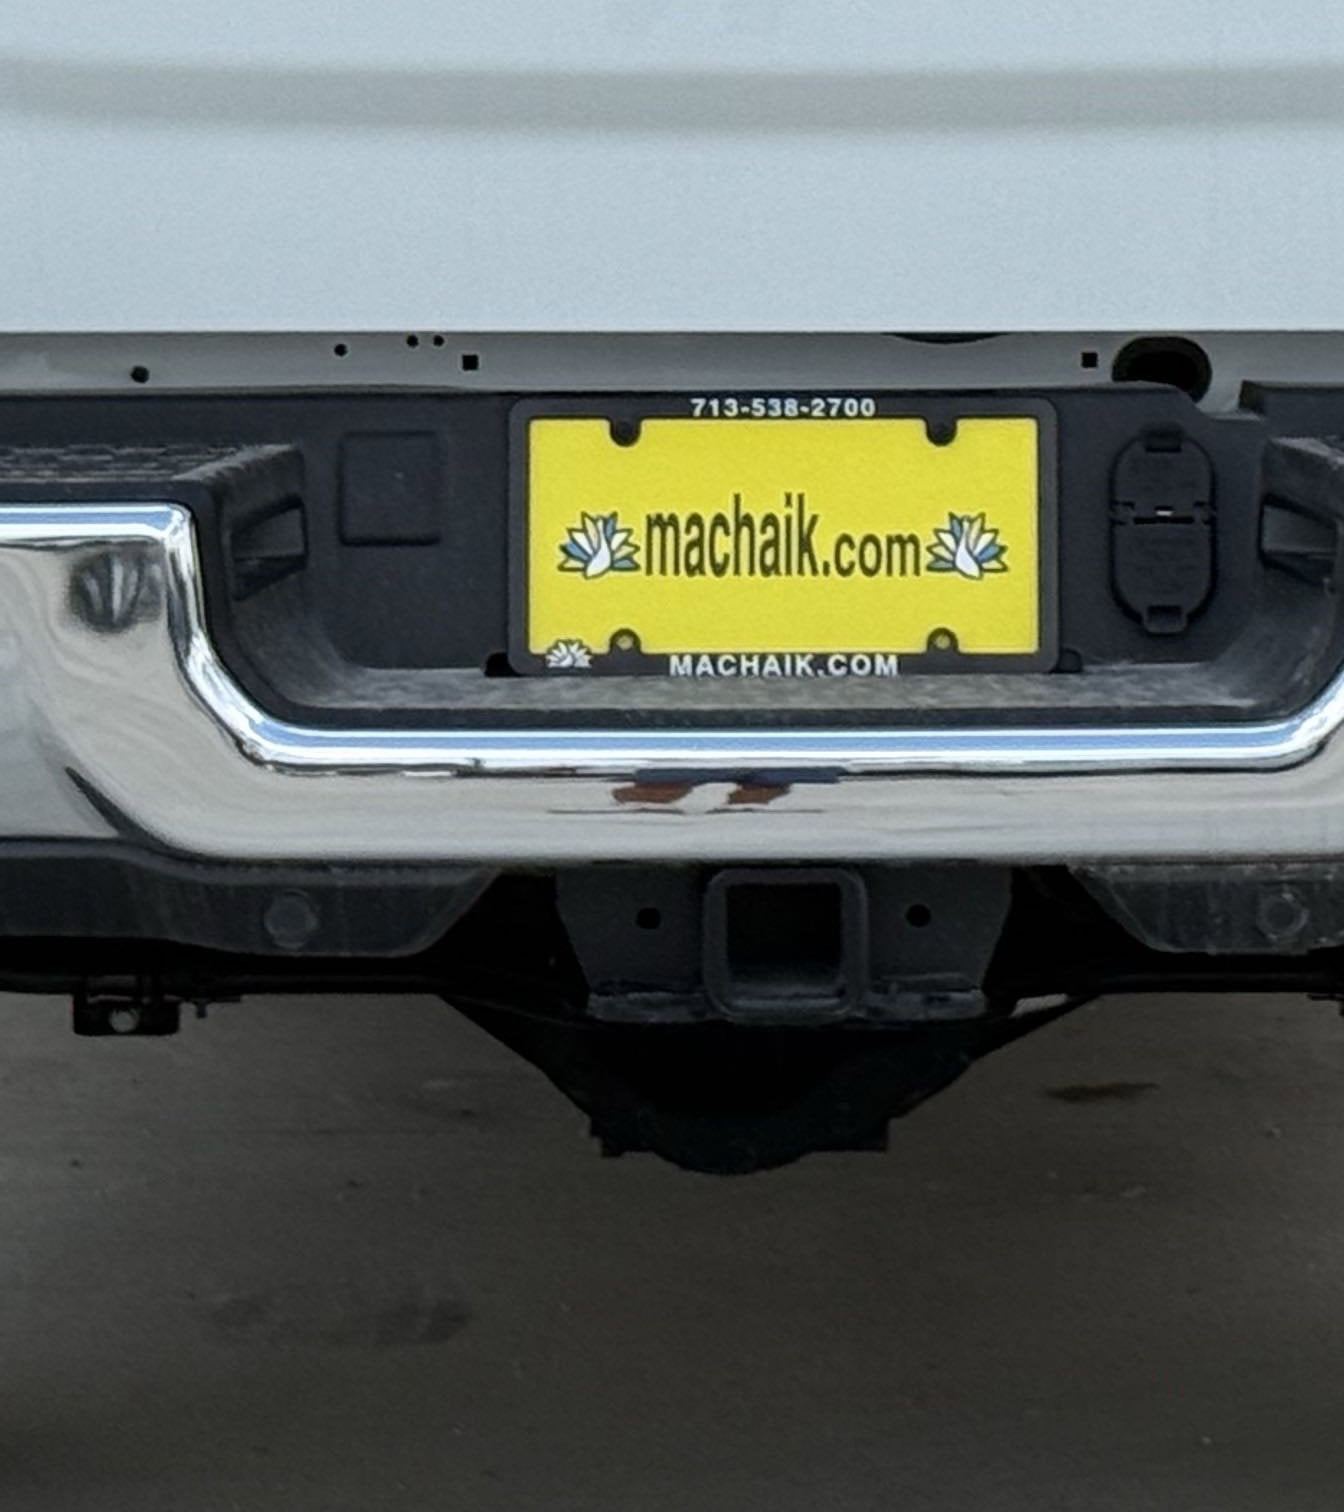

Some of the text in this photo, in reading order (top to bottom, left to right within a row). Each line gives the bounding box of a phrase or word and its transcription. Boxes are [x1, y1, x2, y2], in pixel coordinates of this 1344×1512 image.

[689, 397, 877, 419] 713-538-2700
[644, 491, 923, 579] machaik.com
[668, 653, 899, 677] MACHAIK.COM
